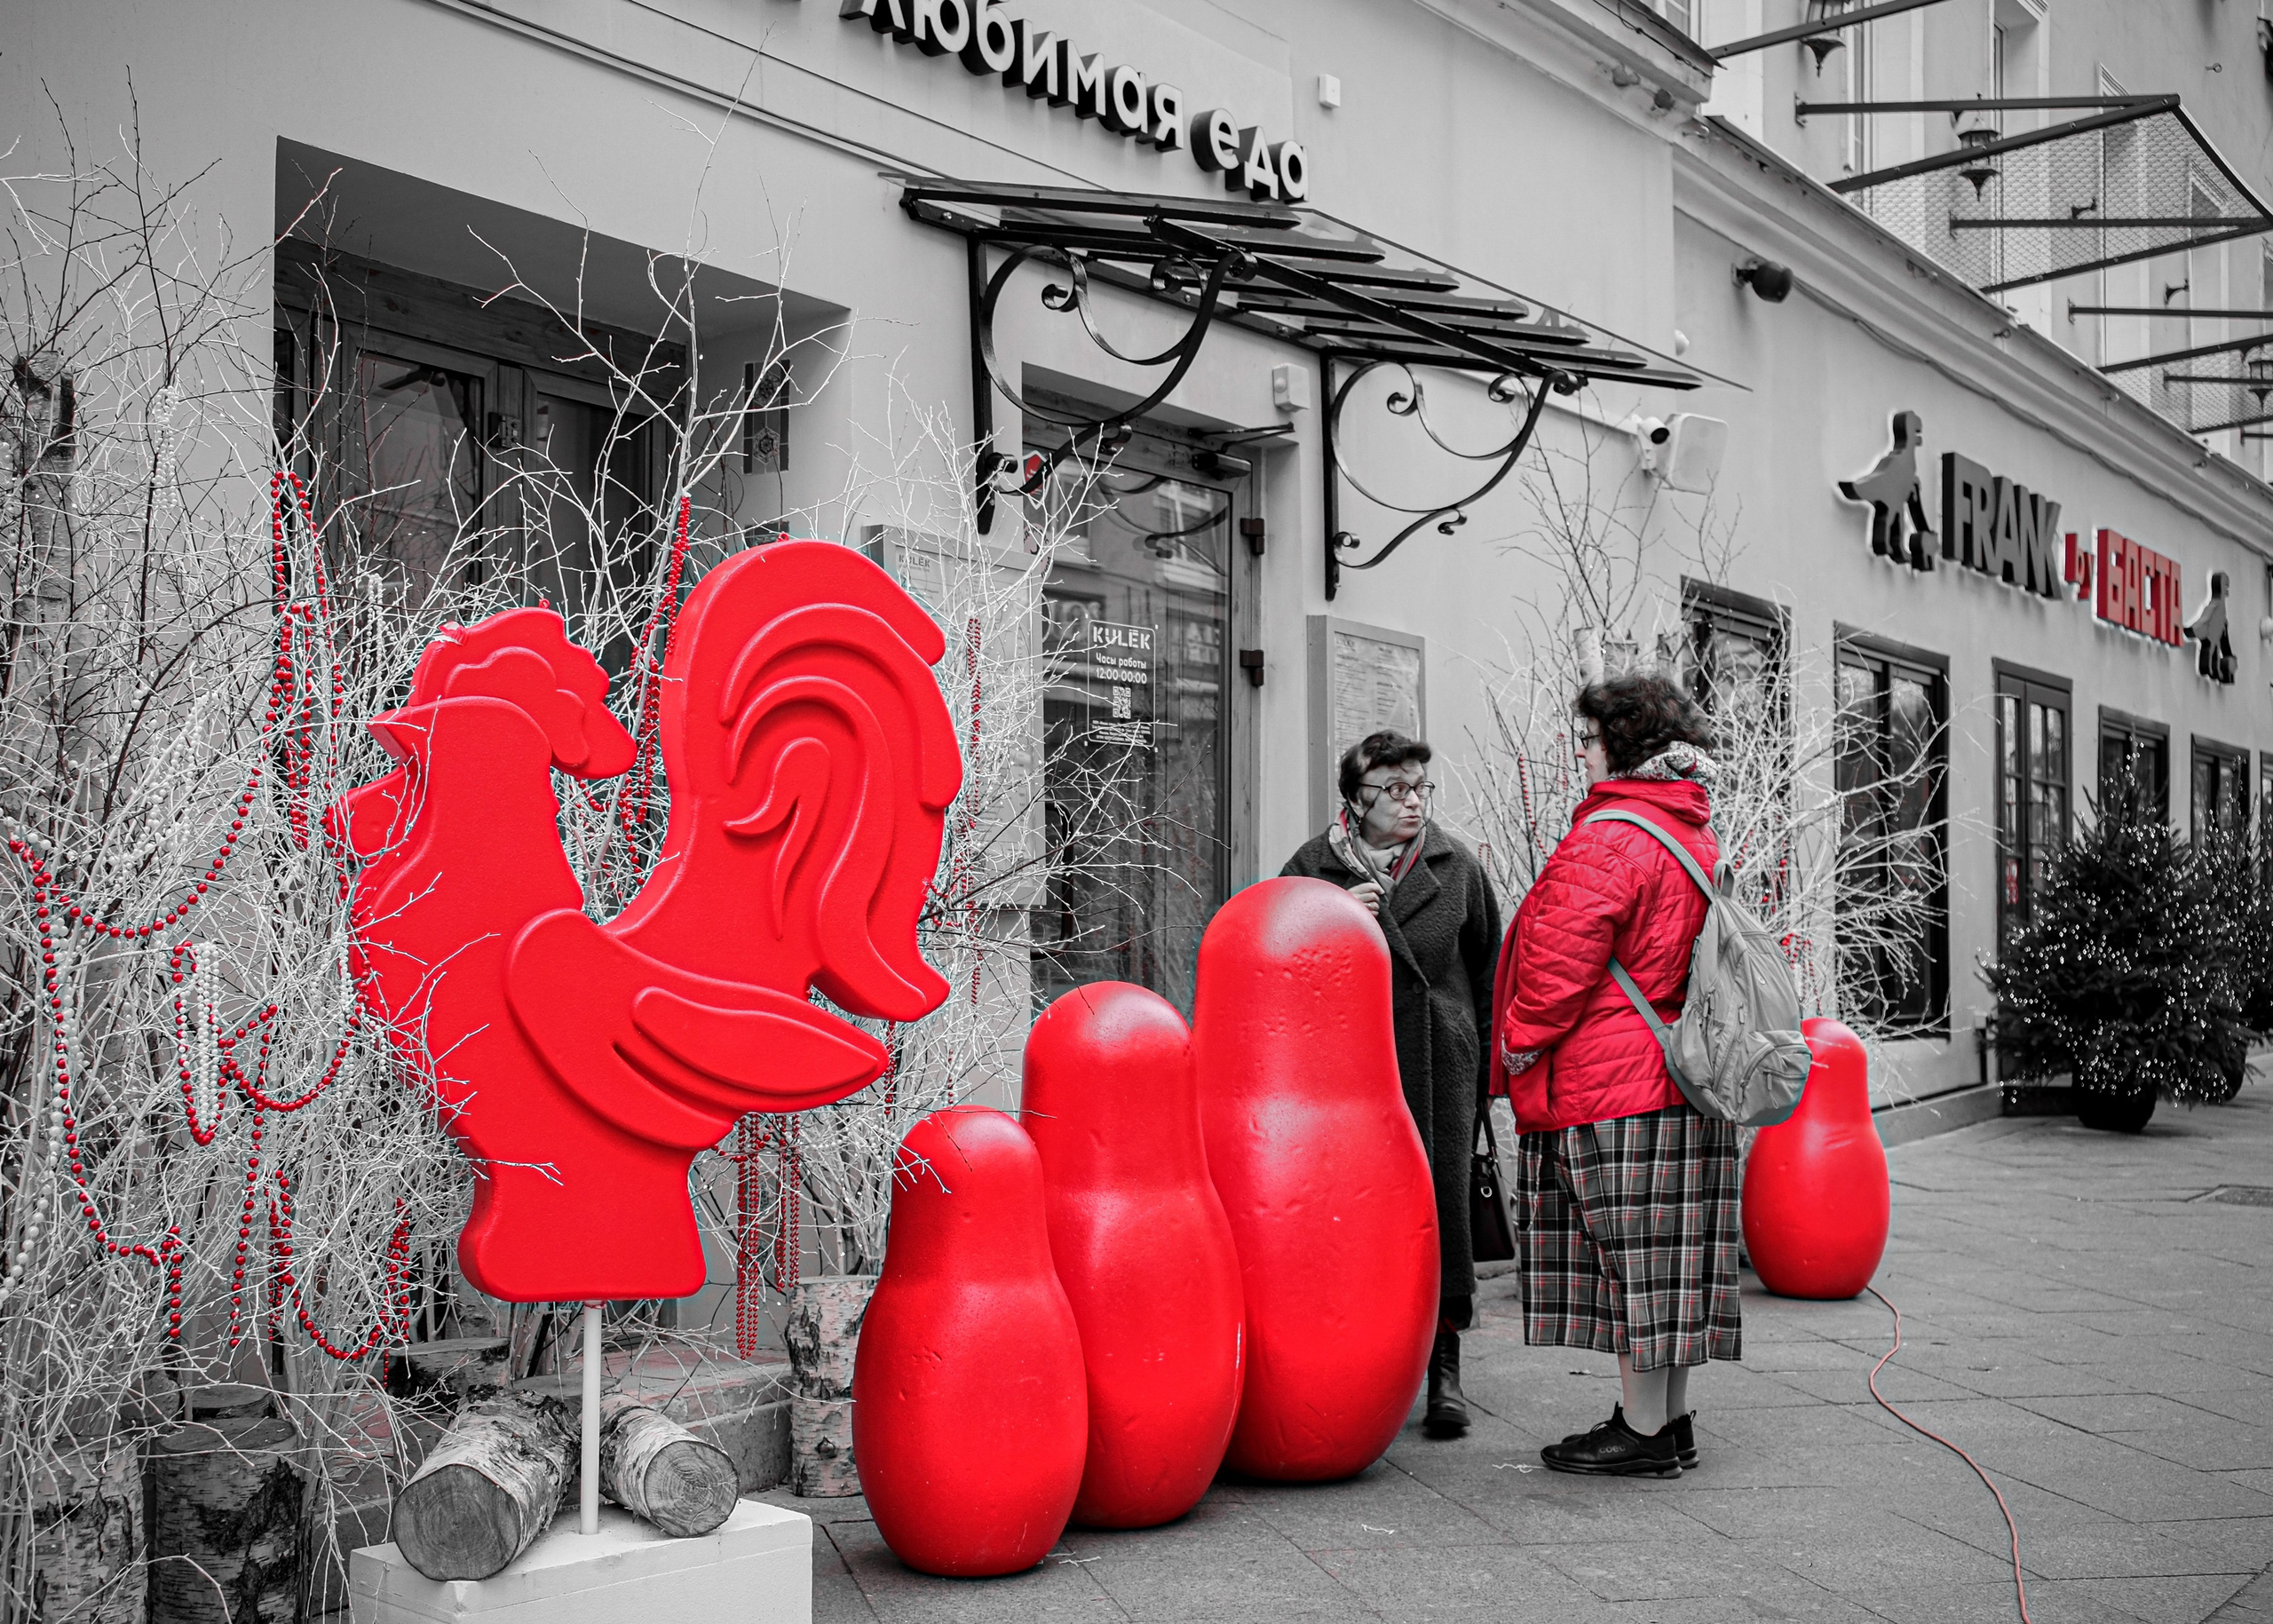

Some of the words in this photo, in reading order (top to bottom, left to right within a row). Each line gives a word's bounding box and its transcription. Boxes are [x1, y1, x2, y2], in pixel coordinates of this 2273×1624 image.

[1192, 108, 1309, 204] еда
[1942, 452, 2063, 601] FRANK
[2064, 533, 2094, 600] by
[1096, 652, 1116, 665] Часы
[1119, 657, 1146, 669] работы
[1096, 667, 1147, 685] 12:00-00:00
